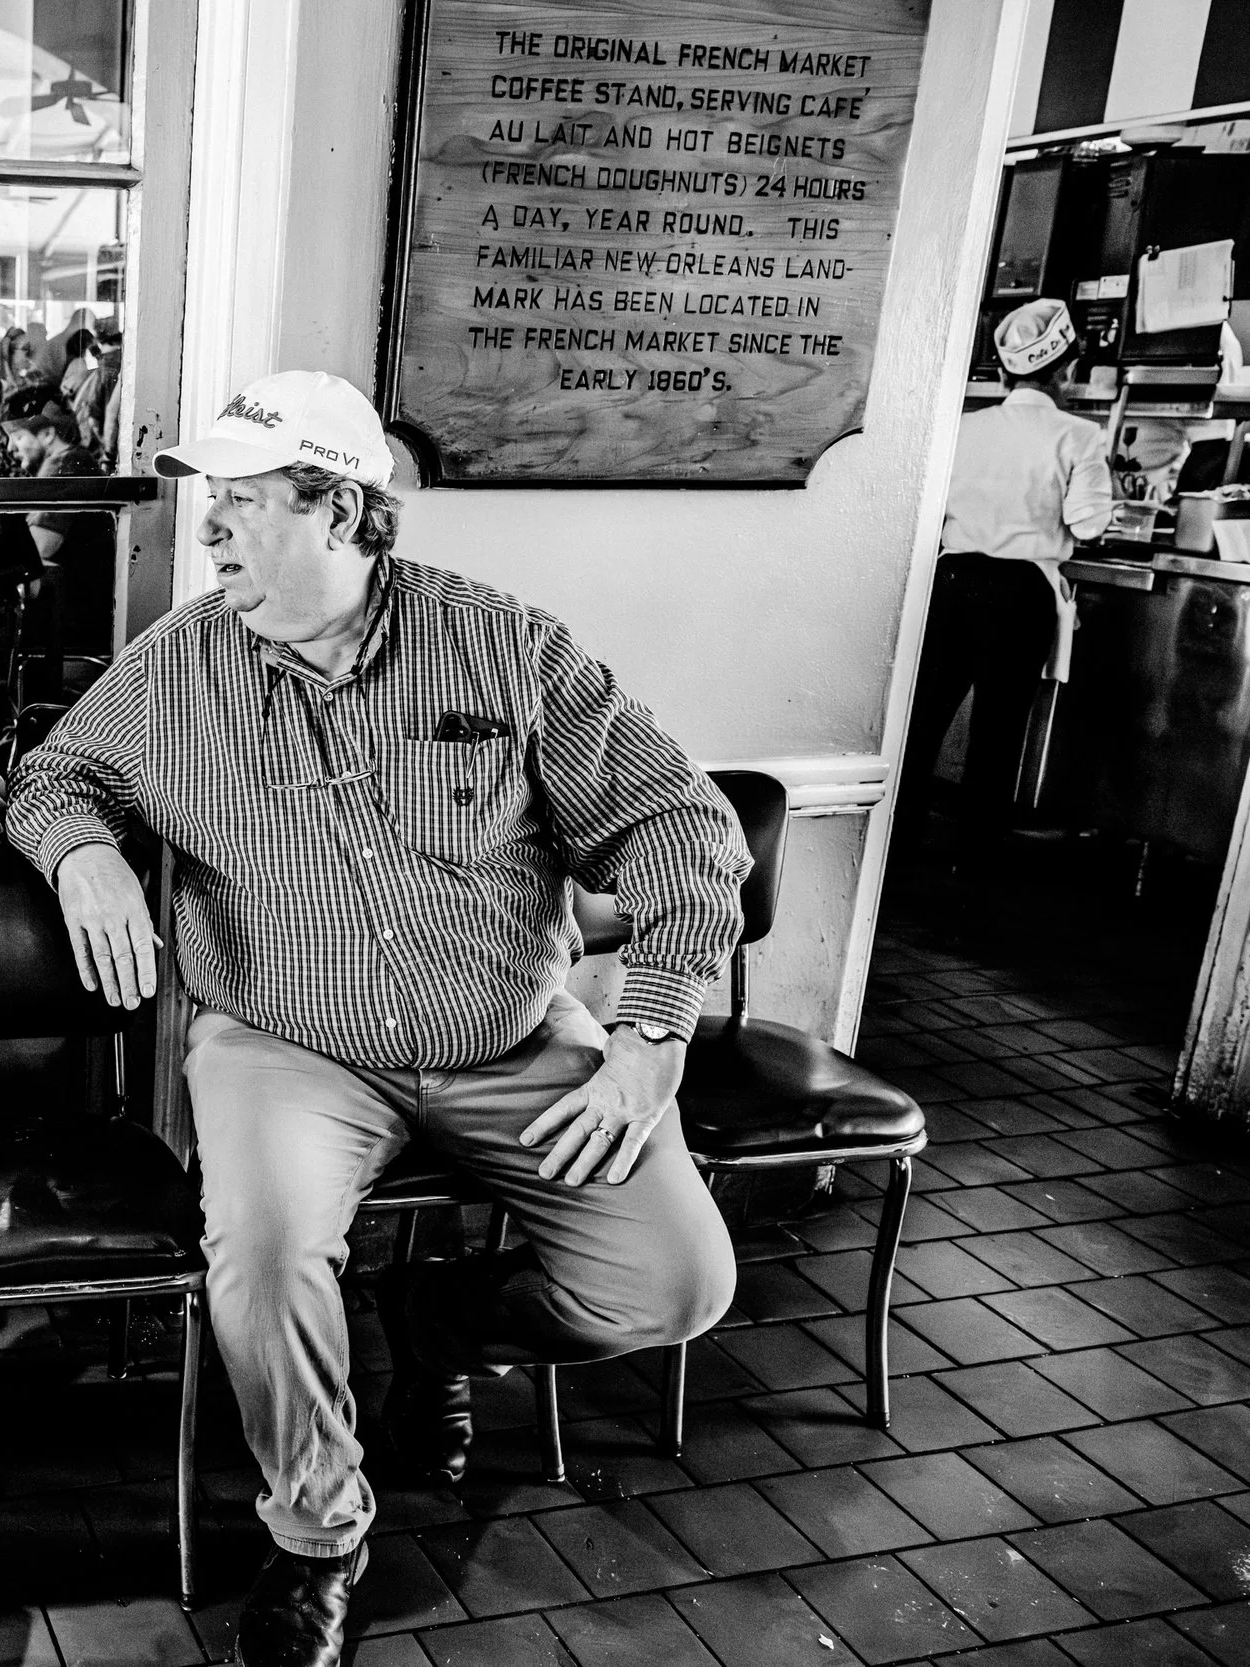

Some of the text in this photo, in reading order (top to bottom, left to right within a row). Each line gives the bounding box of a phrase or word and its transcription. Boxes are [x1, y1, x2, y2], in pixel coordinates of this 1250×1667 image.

[495, 31, 871, 79] THE ORIGINAL FRENCH MARKET
[491, 75, 584, 103] COFFEE
[690, 88, 791, 116] SERVING
[489, 120, 845, 160] AU LAIT AND HOT BEIGNETS
[481, 160, 866, 201] (FRENCH DOUGHNUTS) 24 HOURS
[481, 204, 840, 241] A DAY, YEAR ROUND. THIS
[477, 245, 854, 281] FAMILIAR NEW ORLEANS LAND-
[472, 286, 820, 319] MARK HAS BEEN LOCATED IN
[468, 326, 843, 357] THE FRENCH MARKET SINCE THE
[559, 366, 733, 392] EARLY 1860'S.
[299, 439, 360, 470] PRO V1
